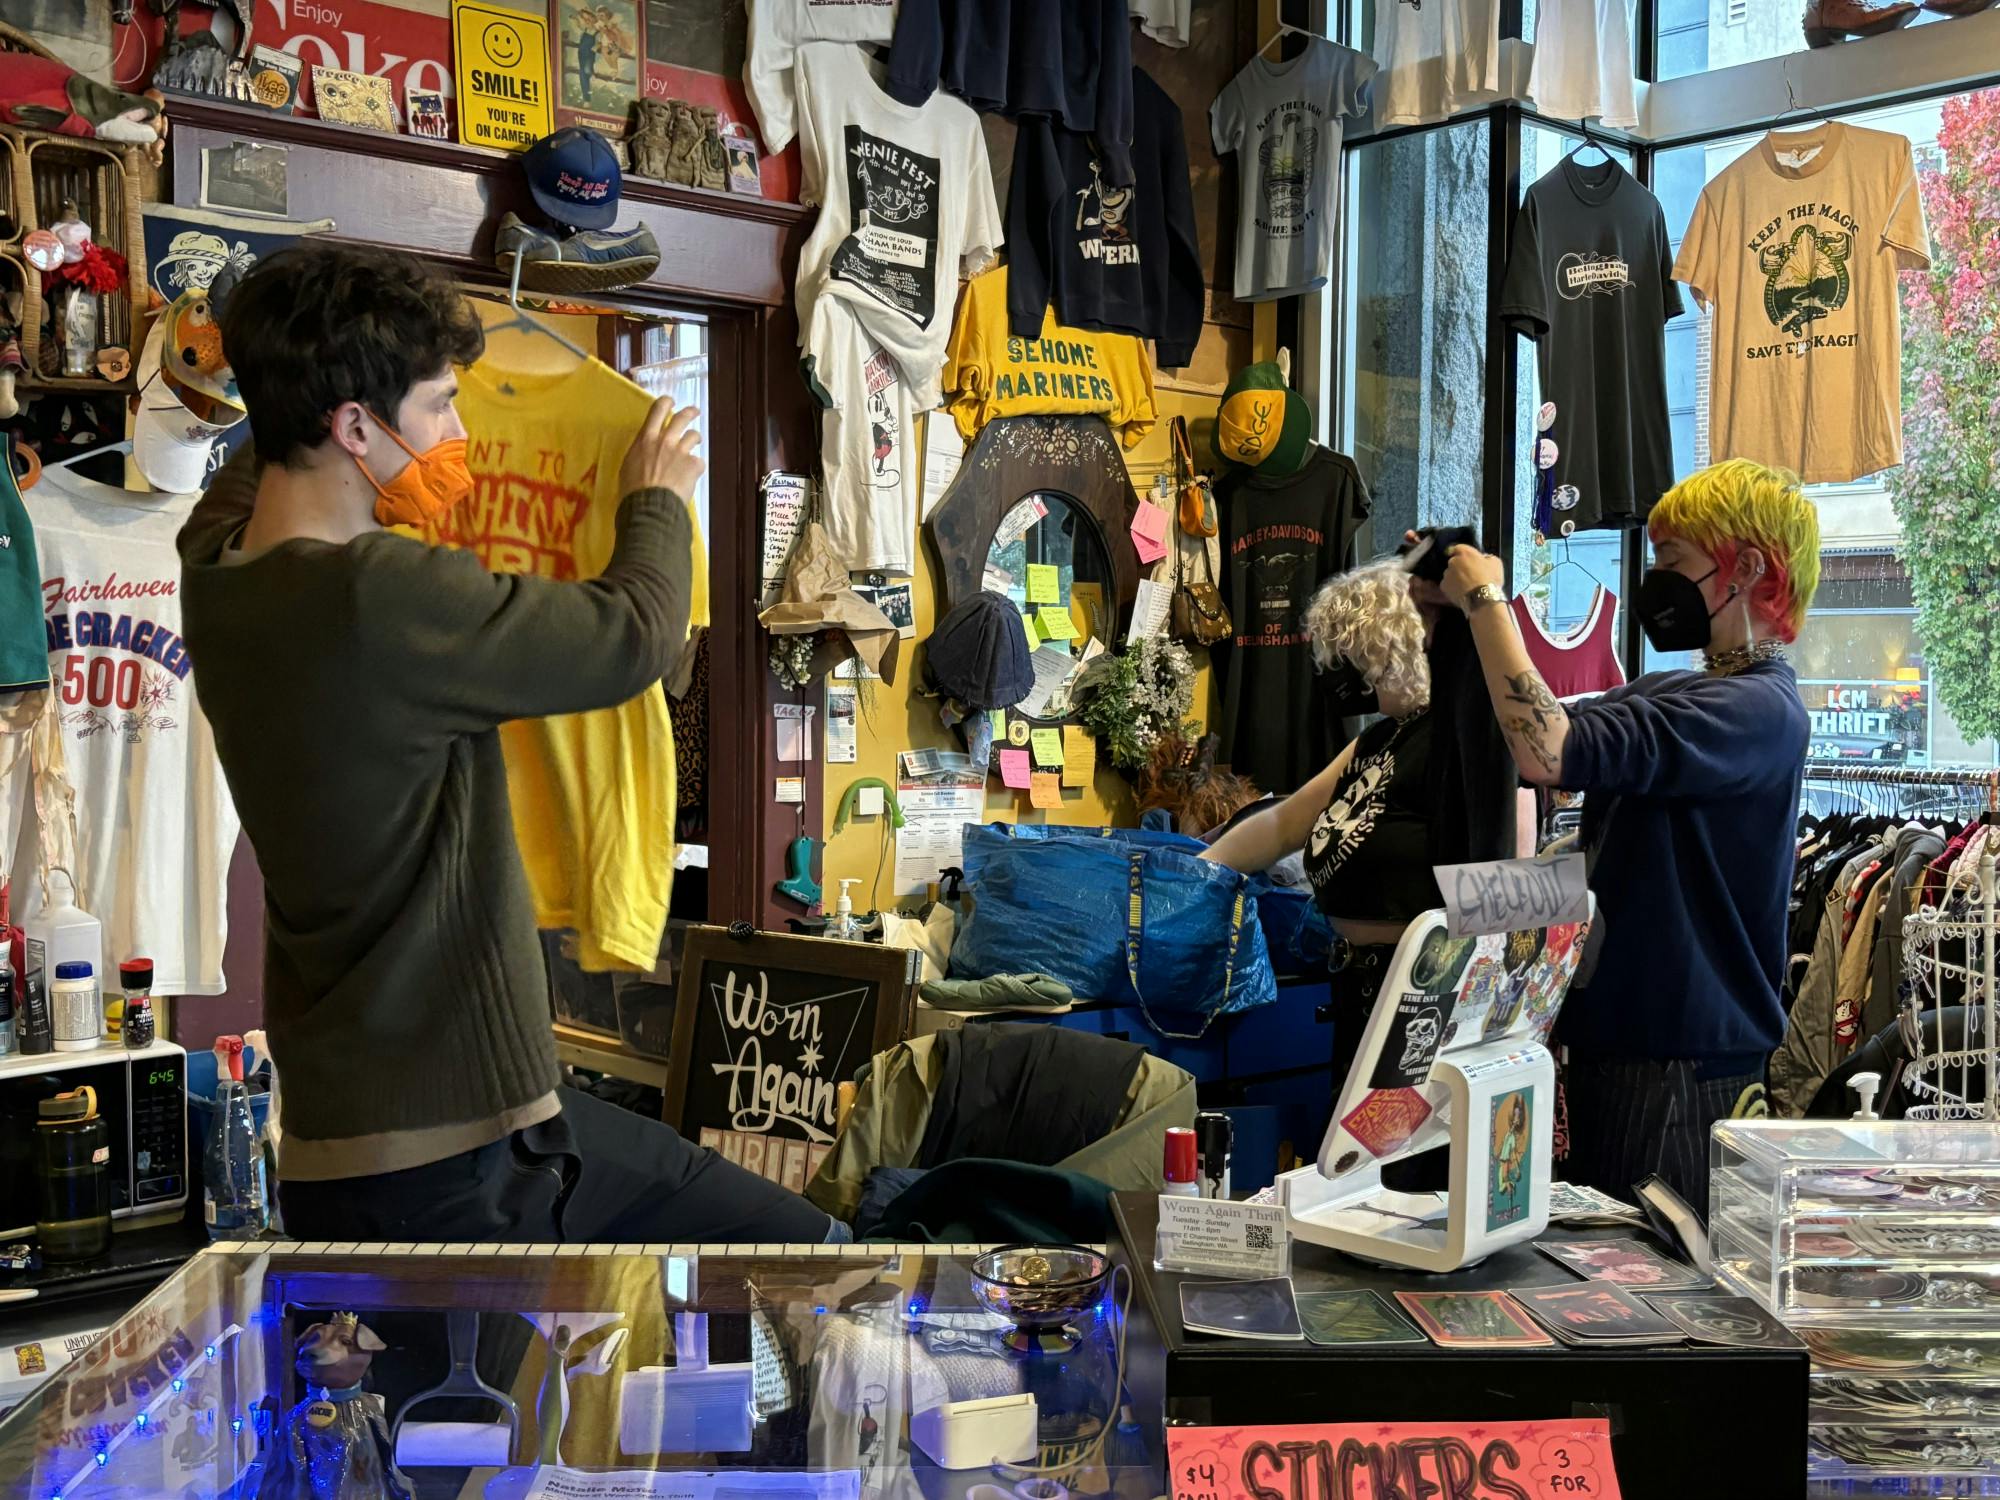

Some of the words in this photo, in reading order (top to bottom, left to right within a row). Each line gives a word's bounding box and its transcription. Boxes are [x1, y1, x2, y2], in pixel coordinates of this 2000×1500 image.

[294, 0, 343, 28] Enjoy
[470, 69, 539, 103] SMILE!
[487, 107, 526, 126] YOU'RE
[476, 123, 491, 138] ON
[494, 126, 538, 145] CAMERA
[902, 156, 936, 190] FEST
[1747, 216, 1782, 253] KEEP
[1786, 202, 1817, 222] THE
[1818, 203, 1861, 237] MAGIC
[891, 243, 922, 256] BANDS
[1078, 238, 1140, 265] WERN
[1007, 337, 1098, 370] SEHOME
[1746, 344, 1783, 359] SAVE
[996, 370, 1113, 401] MARINERS
[537, 448, 566, 481] TO
[579, 461, 599, 487] A
[1231, 524, 1325, 556] HARLEY-DAVIDSON
[41, 572, 178, 614] Fairhaven
[1264, 623, 1282, 635] OF
[75, 610, 193, 682] CRACKER
[61, 654, 142, 710] 500
[1827, 689, 1868, 709] LCM
[1807, 710, 1890, 735] THRIFT
[725, 970, 823, 1042] Worn
[1398, 1004, 1419, 1014] REAL
[1402, 993, 1421, 1003] TIME
[711, 1036, 836, 1143] Again
[1163, 1200, 1200, 1215] Worn
[1204, 1204, 1241, 1219] Again
[1244, 1207, 1282, 1222] Thrift
[1172, 1215, 1200, 1225] Tuesday
[1204, 1218, 1231, 1229] Sunday
[1241, 1436, 1531, 1500] STICKERS
[1553, 1448, 1571, 1469] 3
[1186, 1464, 1215, 1488] $4
[1550, 1474, 1592, 1493] FOR
